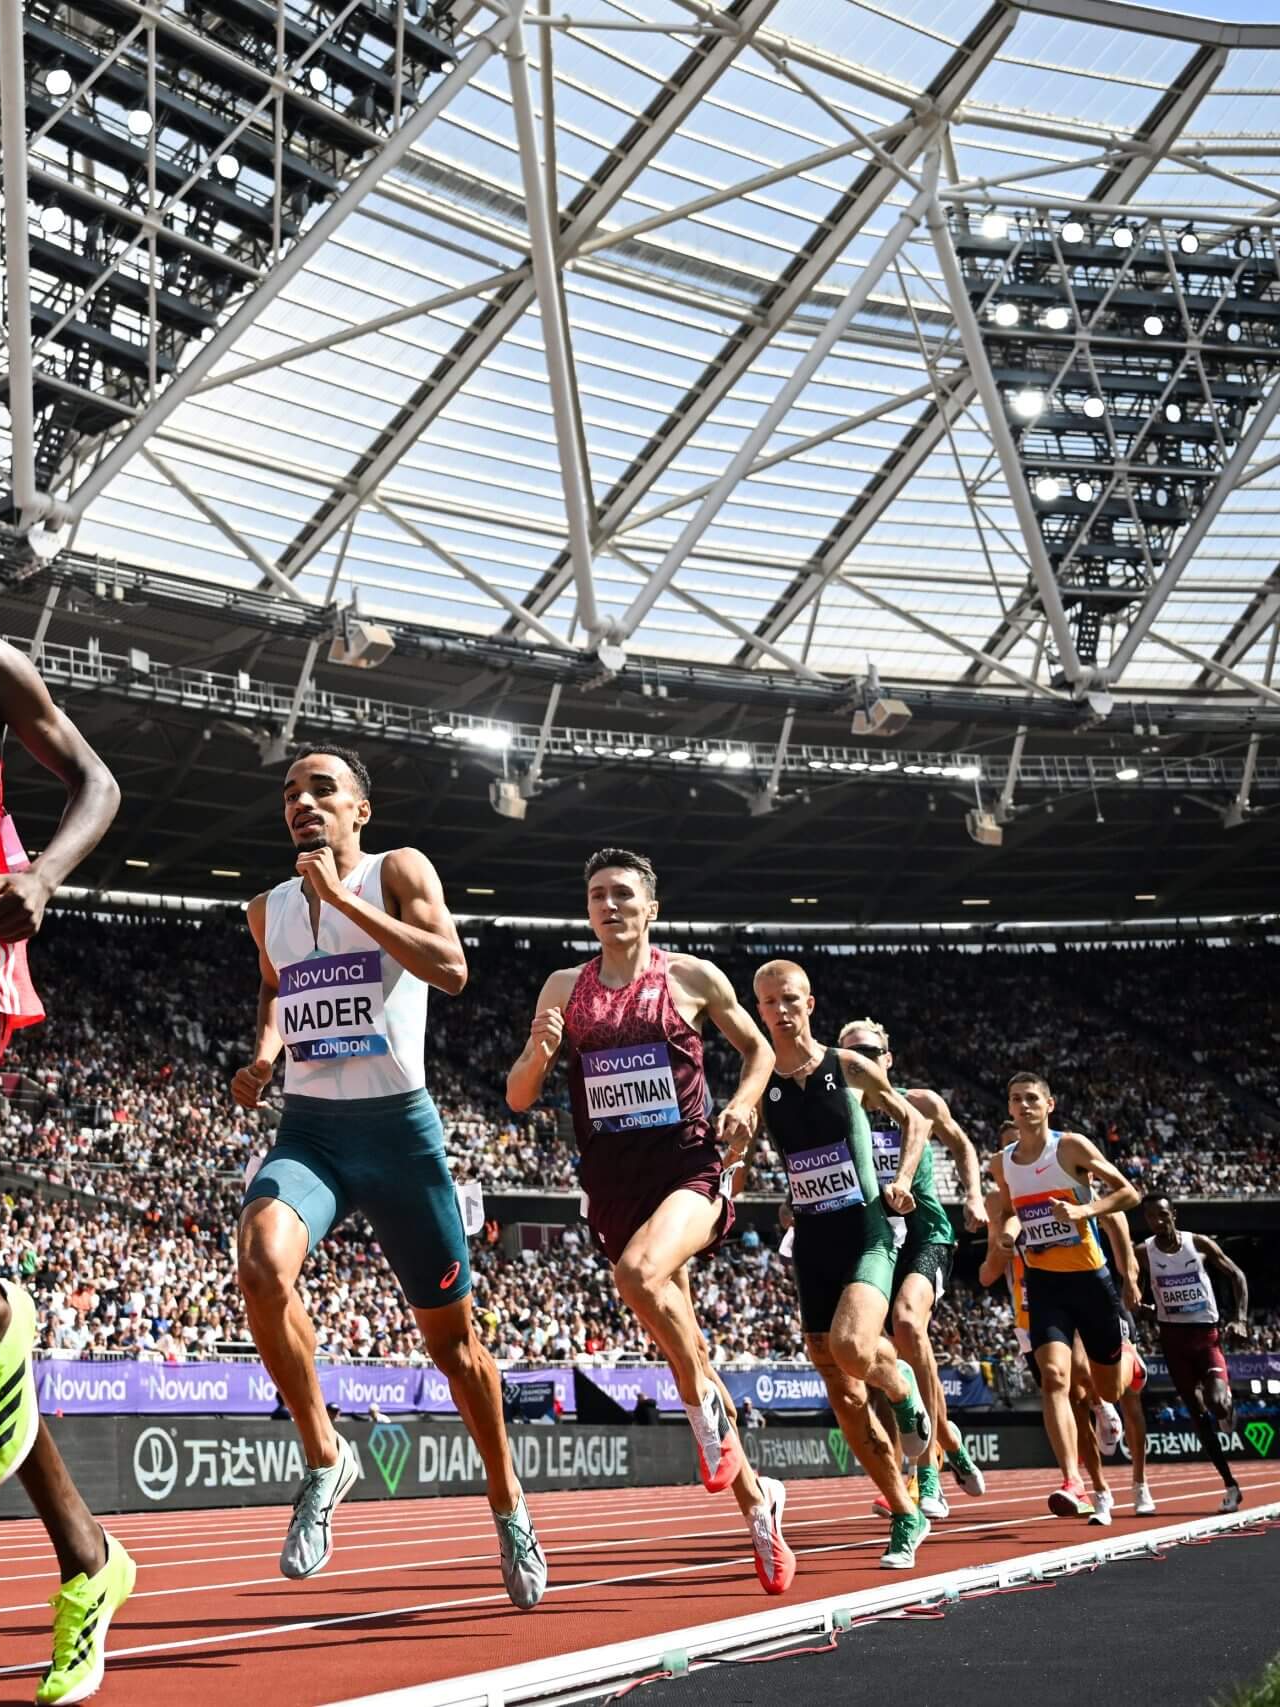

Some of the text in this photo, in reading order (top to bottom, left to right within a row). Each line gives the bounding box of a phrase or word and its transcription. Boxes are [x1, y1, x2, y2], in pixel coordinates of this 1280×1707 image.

[288, 964, 364, 991] Novuna
[284, 996, 374, 1034] NADER
[311, 1039, 370, 1056] LONDON
[589, 1053, 656, 1073] Novuna
[588, 1077, 672, 1110] WIGHTMAN
[620, 1112, 668, 1128] LONDON
[791, 1169, 856, 1199] FARKEN
[1027, 1221, 1071, 1240] MYERS
[1163, 1288, 1204, 1303] BAREGA
[44, 1373, 126, 1401] Novuna
[149, 1374, 228, 1401] Novuna
[339, 1377, 406, 1402] Novuna
[418, 1434, 629, 1482] DIAMND LEAGUE
